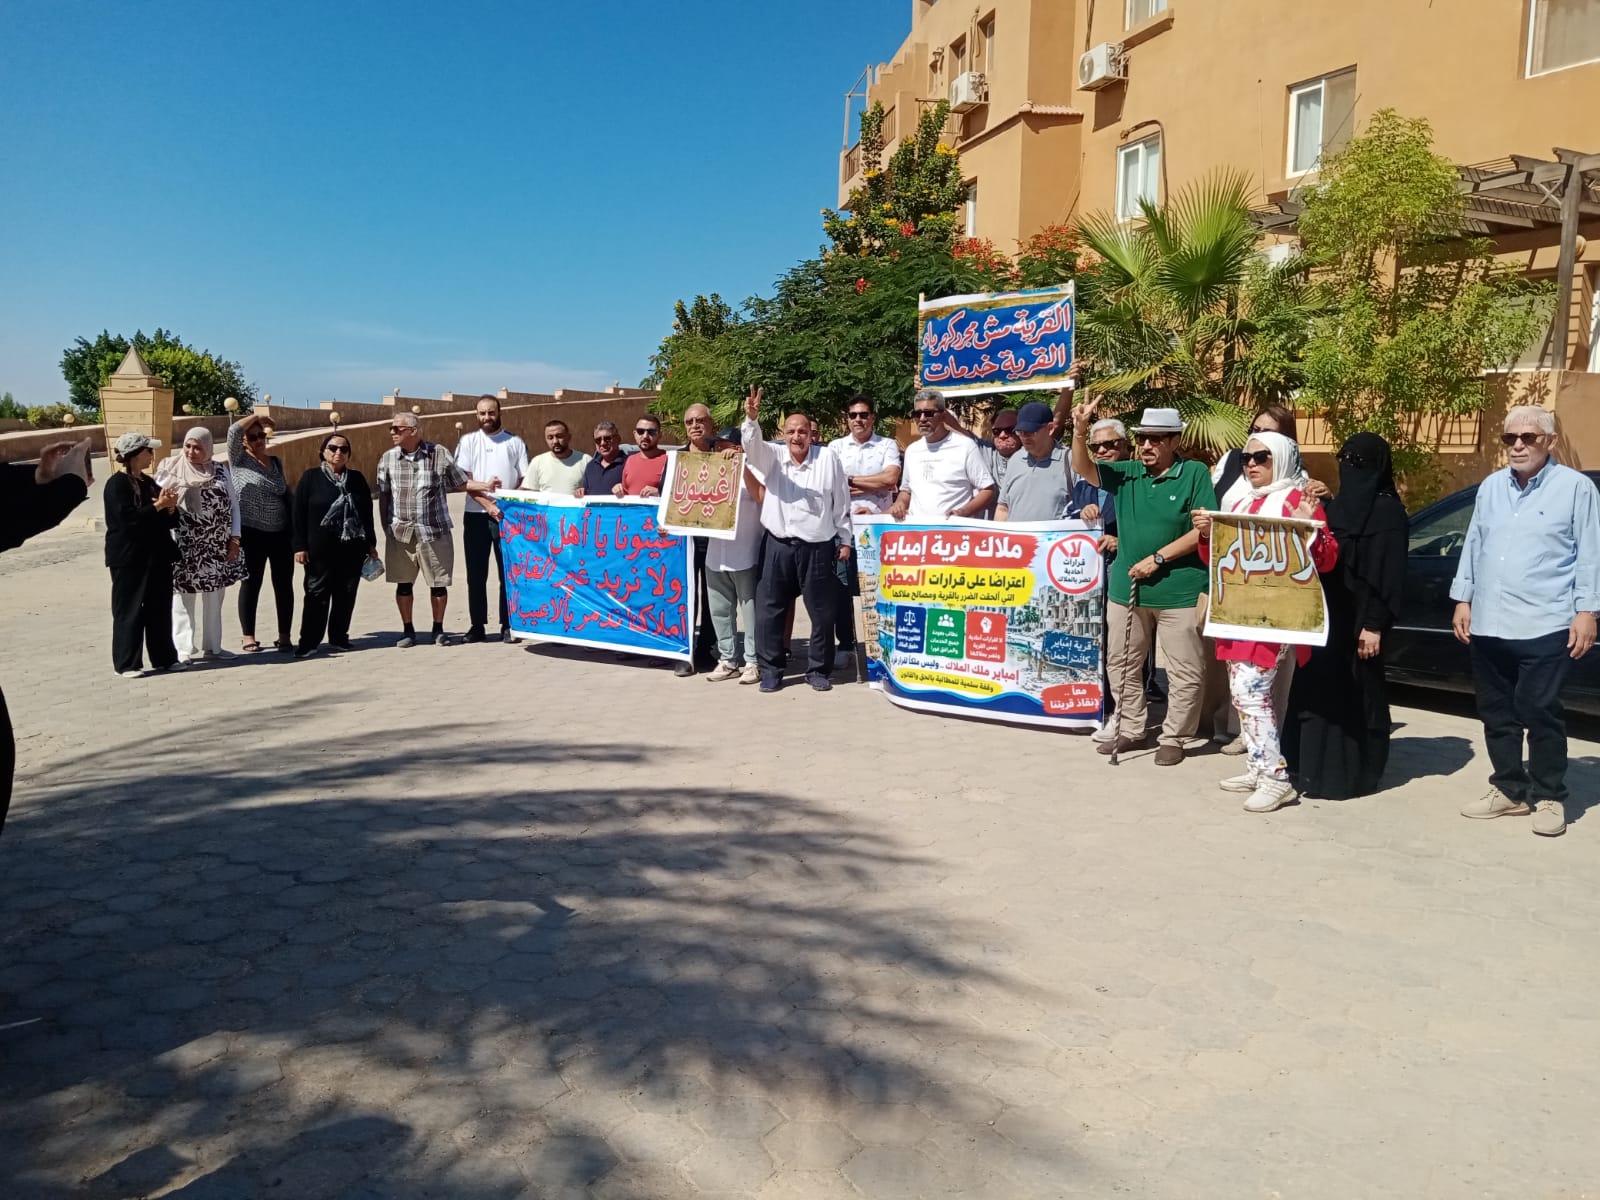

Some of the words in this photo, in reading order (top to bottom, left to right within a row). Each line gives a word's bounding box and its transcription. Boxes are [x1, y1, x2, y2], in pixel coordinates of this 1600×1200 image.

[973, 315, 1012, 349] مش
[1012, 302, 1071, 345] القرية
[953, 322, 979, 350] مجرد
[924, 354, 1000, 382] خدمات
[998, 343, 1067, 380] القرية
[673, 455, 740, 518] أغيثونا
[549, 508, 592, 554] أهل
[595, 515, 608, 557] يا
[884, 534, 928, 563] إمباير
[931, 534, 971, 562] قرية
[975, 535, 1023, 560] ملاك
[1063, 558, 1086, 568] قرارات
[1217, 520, 1288, 605] للظلم
[552, 560, 591, 591] غير
[645, 563, 682, 604] ولا
[882, 568, 926, 589] المطور
[928, 571, 965, 589] قرارات
[967, 574, 986, 590] على
[596, 567, 641, 602] نريد
[892, 590, 910, 599] ملاكها
[911, 590, 937, 601] ومصالح
[938, 591, 959, 601] بالقرية
[961, 591, 978, 602] الضرر
[1001, 593, 1015, 605] التي
[573, 607, 624, 631] تدمر
[1074, 640, 1092, 652] قرية
[921, 660, 939, 669] وليس
[945, 661, 970, 673] الملاك
[1071, 653, 1091, 664] كانت
[901, 672, 919, 681] والقانون
[919, 674, 934, 682] بالحق
[971, 665, 990, 676] ملك
[991, 668, 1020, 685] إمباير
[936, 675, 960, 685] للمطالبة
[960, 677, 979, 688] سلمية
[980, 682, 994, 693] وقفة
[1050, 698, 1074, 710] قريتنا
